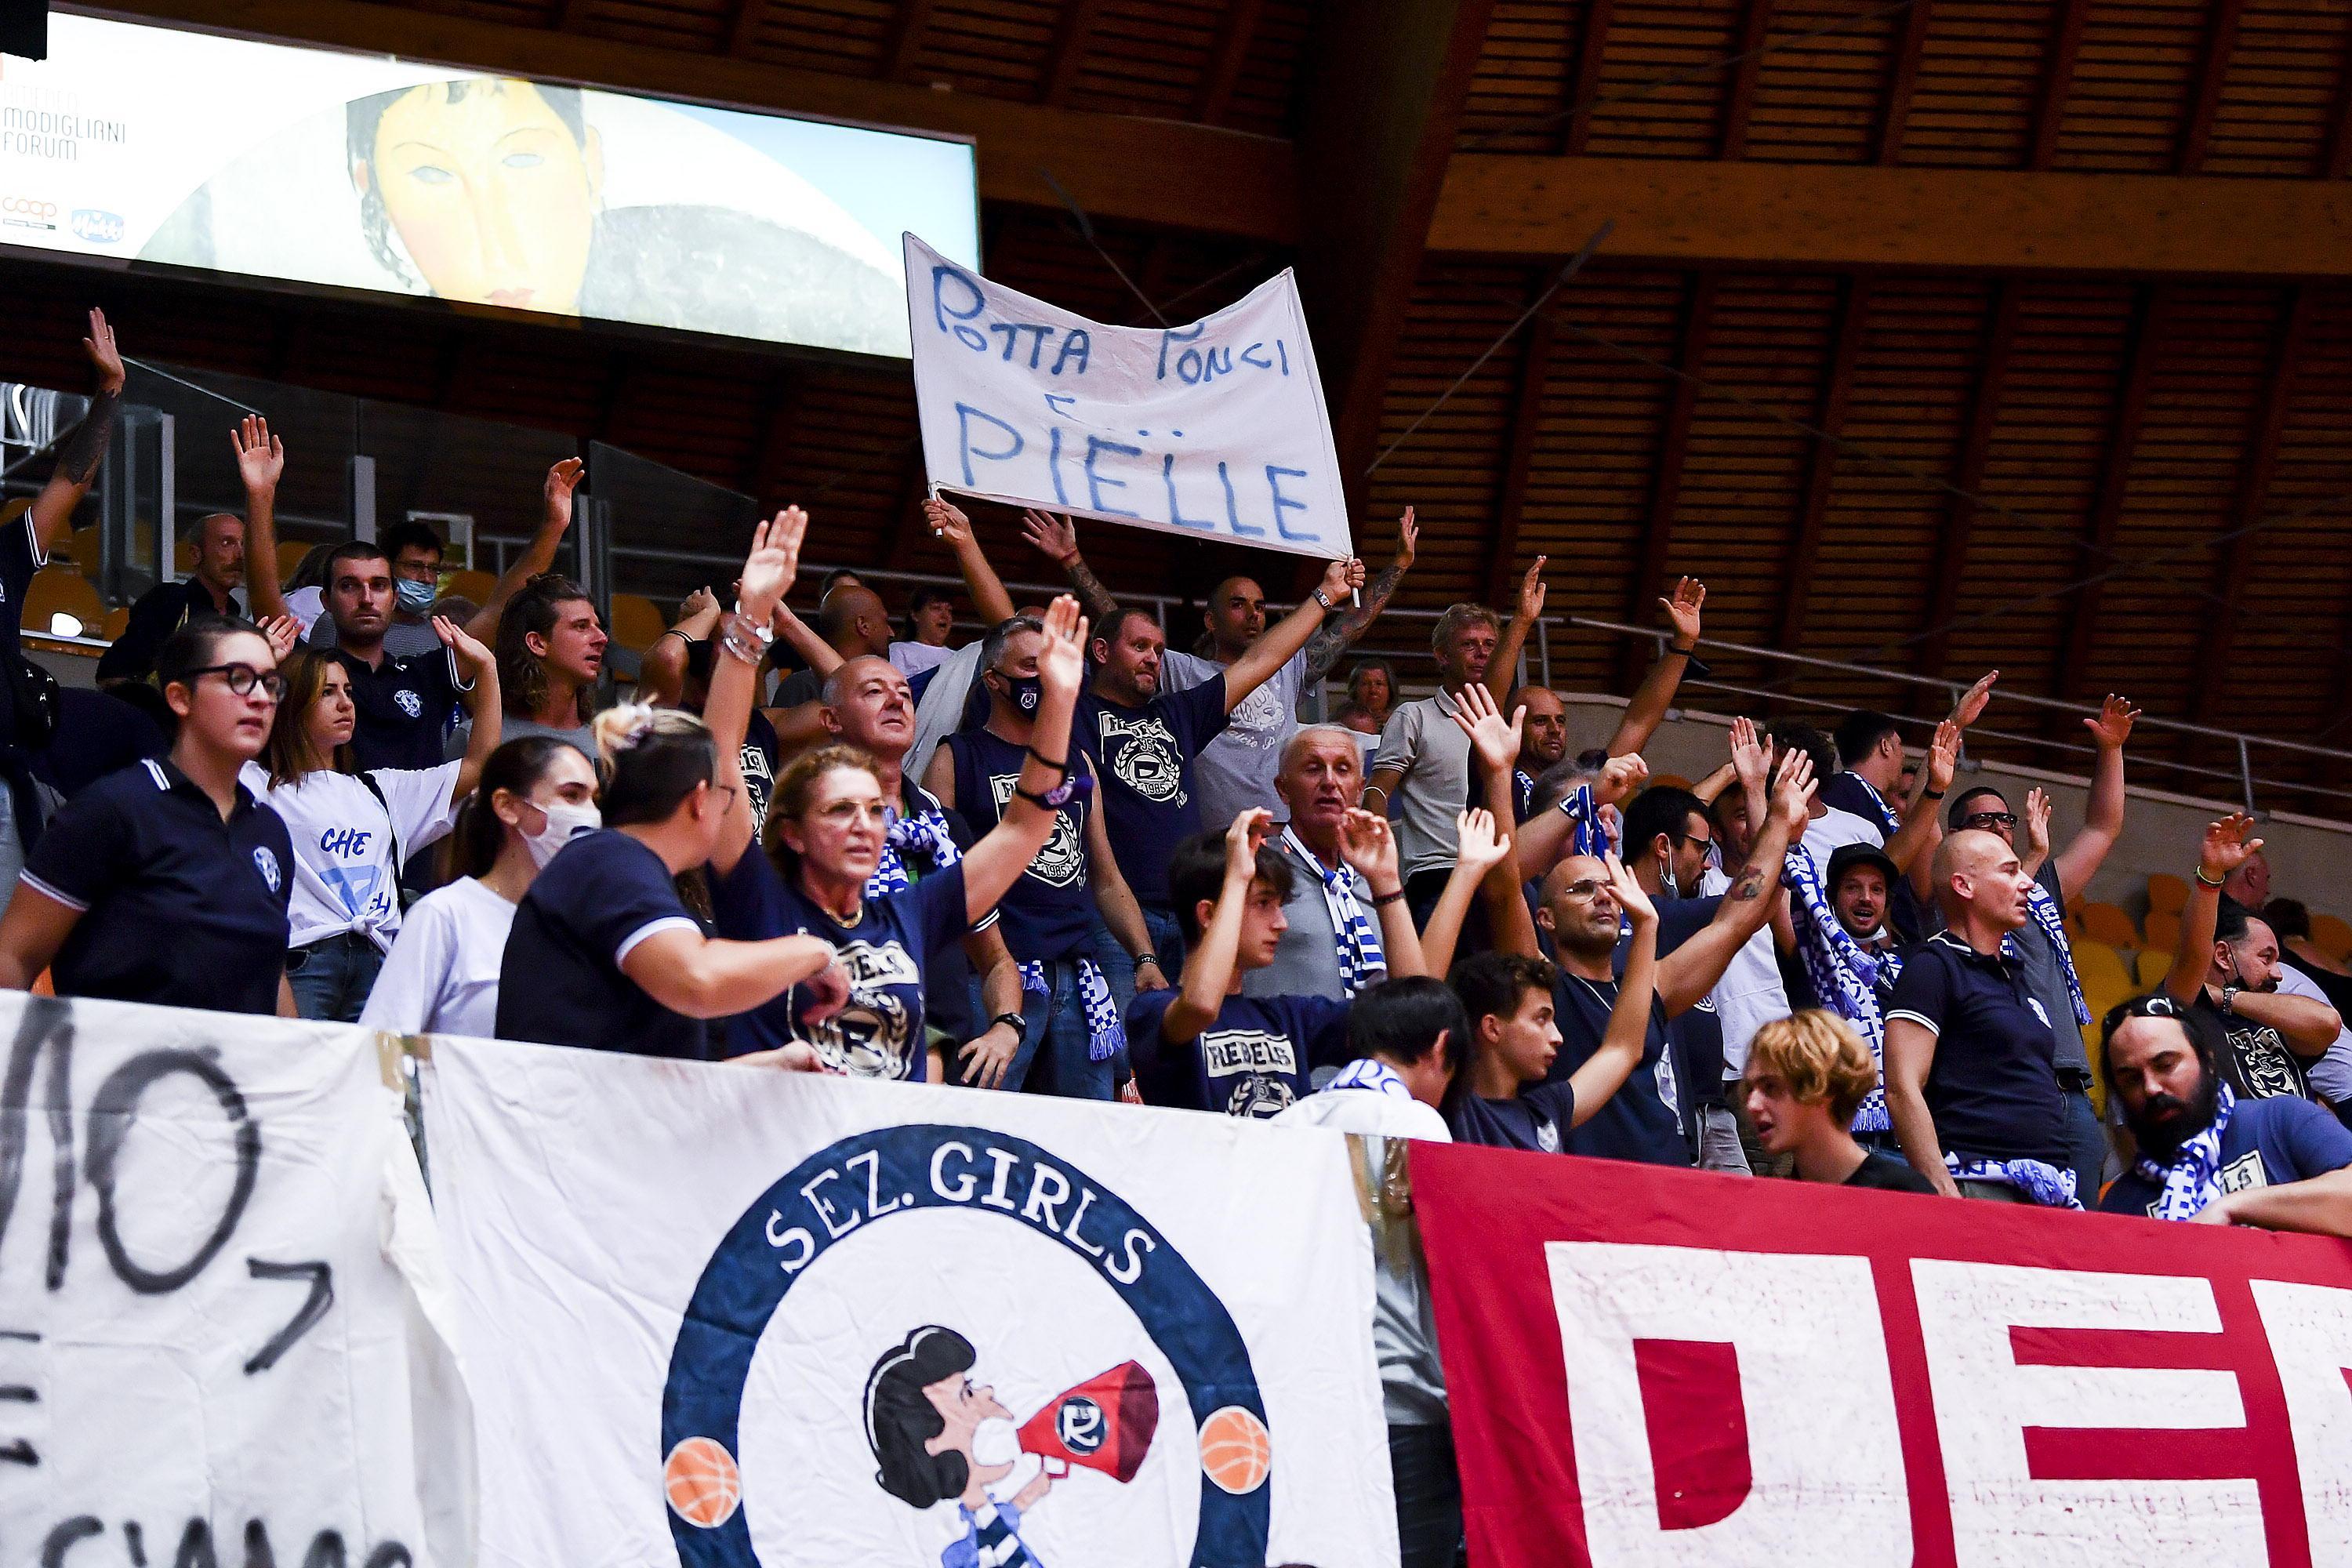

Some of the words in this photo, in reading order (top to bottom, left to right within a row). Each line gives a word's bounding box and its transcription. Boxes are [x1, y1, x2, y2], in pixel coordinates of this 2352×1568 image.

[3, 107, 125, 144] MODIGLIANI
[3, 131, 77, 161] FORUM
[2, 197, 57, 220] coop
[954, 401, 1321, 542] PIELLE
[1144, 784, 1167, 794] 1985
[320, 827, 372, 859] CHE
[1044, 864, 1068, 877] 1985
[1207, 1040, 1292, 1070] REBELS
[764, 1149, 916, 1276] SEZ.
[928, 1140, 1157, 1287] GIRLS
[1542, 1240, 2352, 1568] DE
